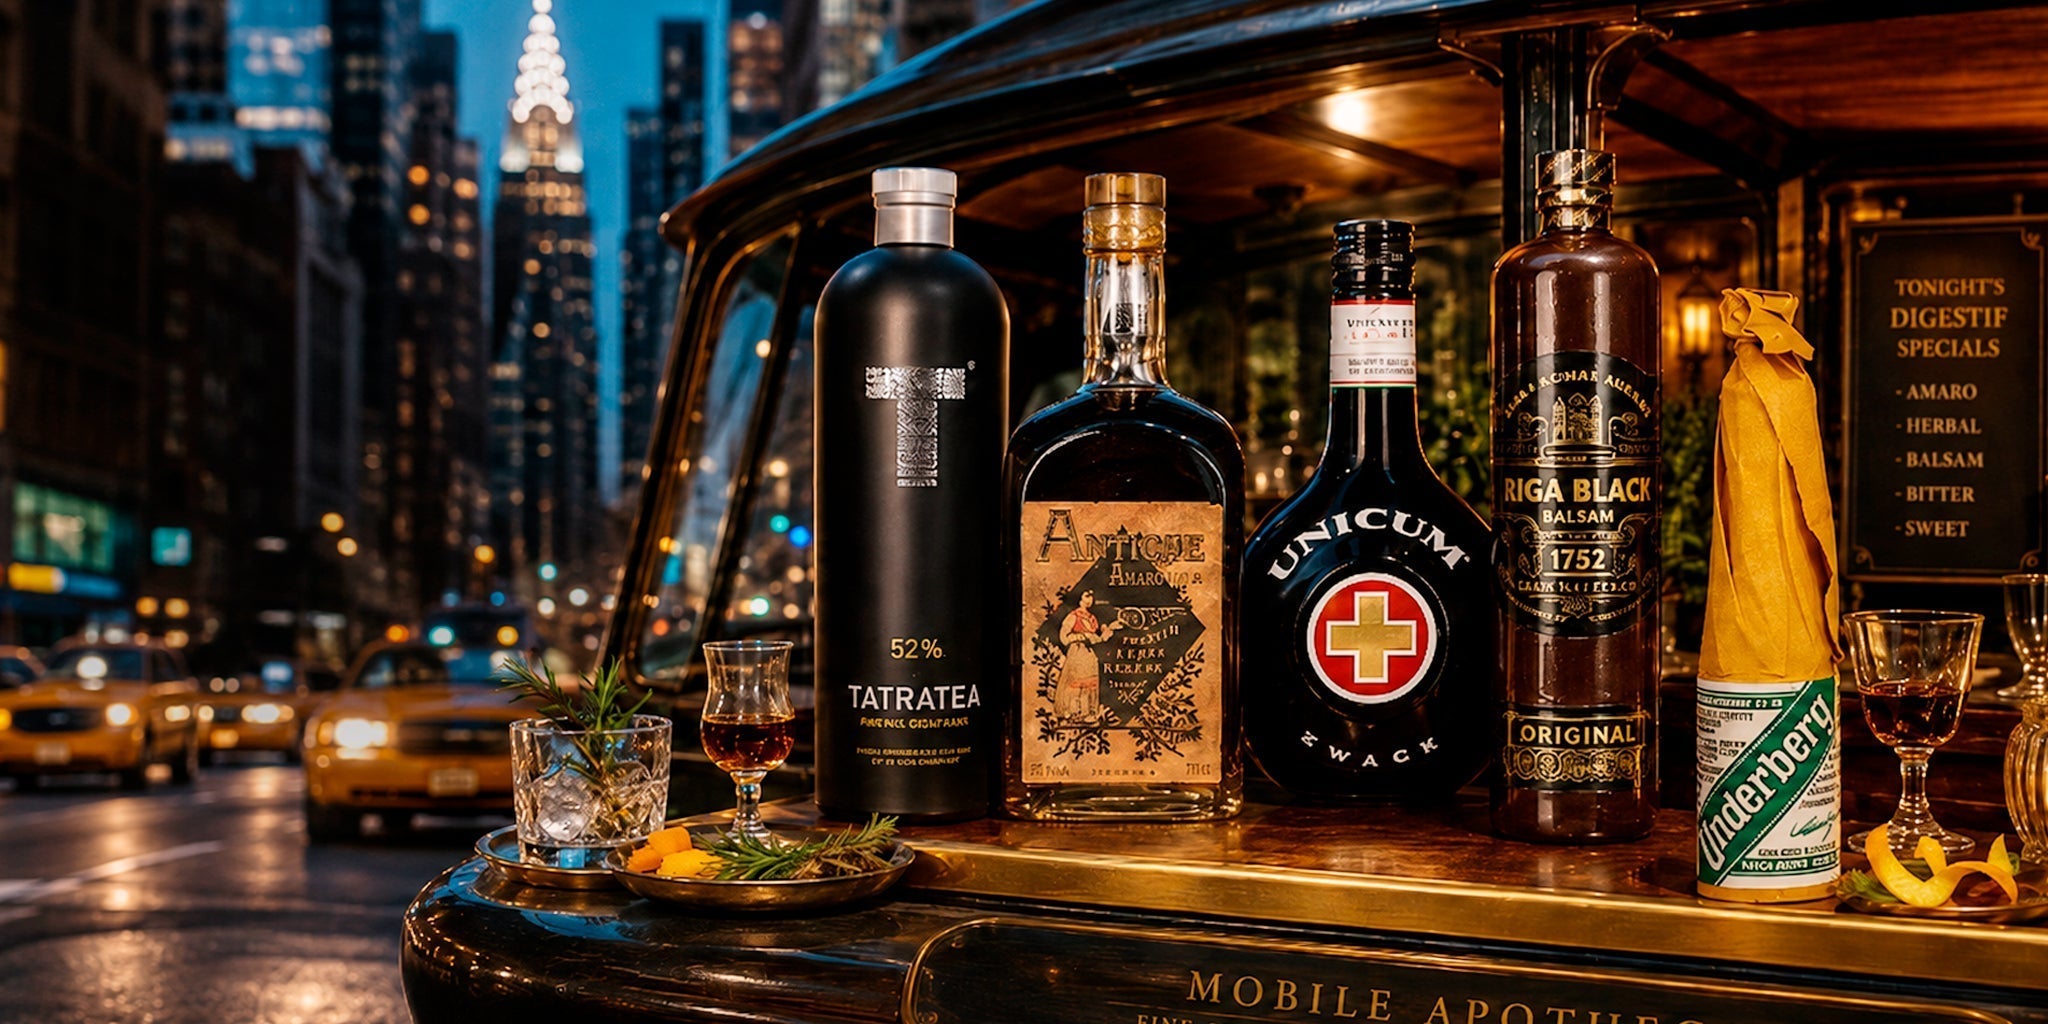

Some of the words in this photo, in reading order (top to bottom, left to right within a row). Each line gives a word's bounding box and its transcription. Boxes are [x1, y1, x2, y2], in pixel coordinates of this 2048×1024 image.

[1894, 278, 2006, 296] TONIGHT'S
[1890, 306, 2009, 329] DIGESTIF
[1897, 338, 2001, 358] SPECIALS
[1906, 383, 1978, 400] AMARO
[1906, 417, 1982, 434] HERBAL
[1906, 451, 1984, 468] BALSAM
[1504, 477, 1565, 503] RIGA
[1573, 477, 1651, 503] BLACK
[1906, 485, 1976, 502] BITTER
[1542, 509, 1615, 524] BALSAM
[1905, 519, 1970, 537] SWEET
[1267, 507, 1466, 581] UNICUM
[1549, 548, 1606, 571] 1752
[848, 683, 981, 711] TATRATEA
[1520, 724, 1636, 745] ORIGINAL
[1699, 693, 1836, 872] Underberg
[1186, 969, 1392, 1022] MOBILE
